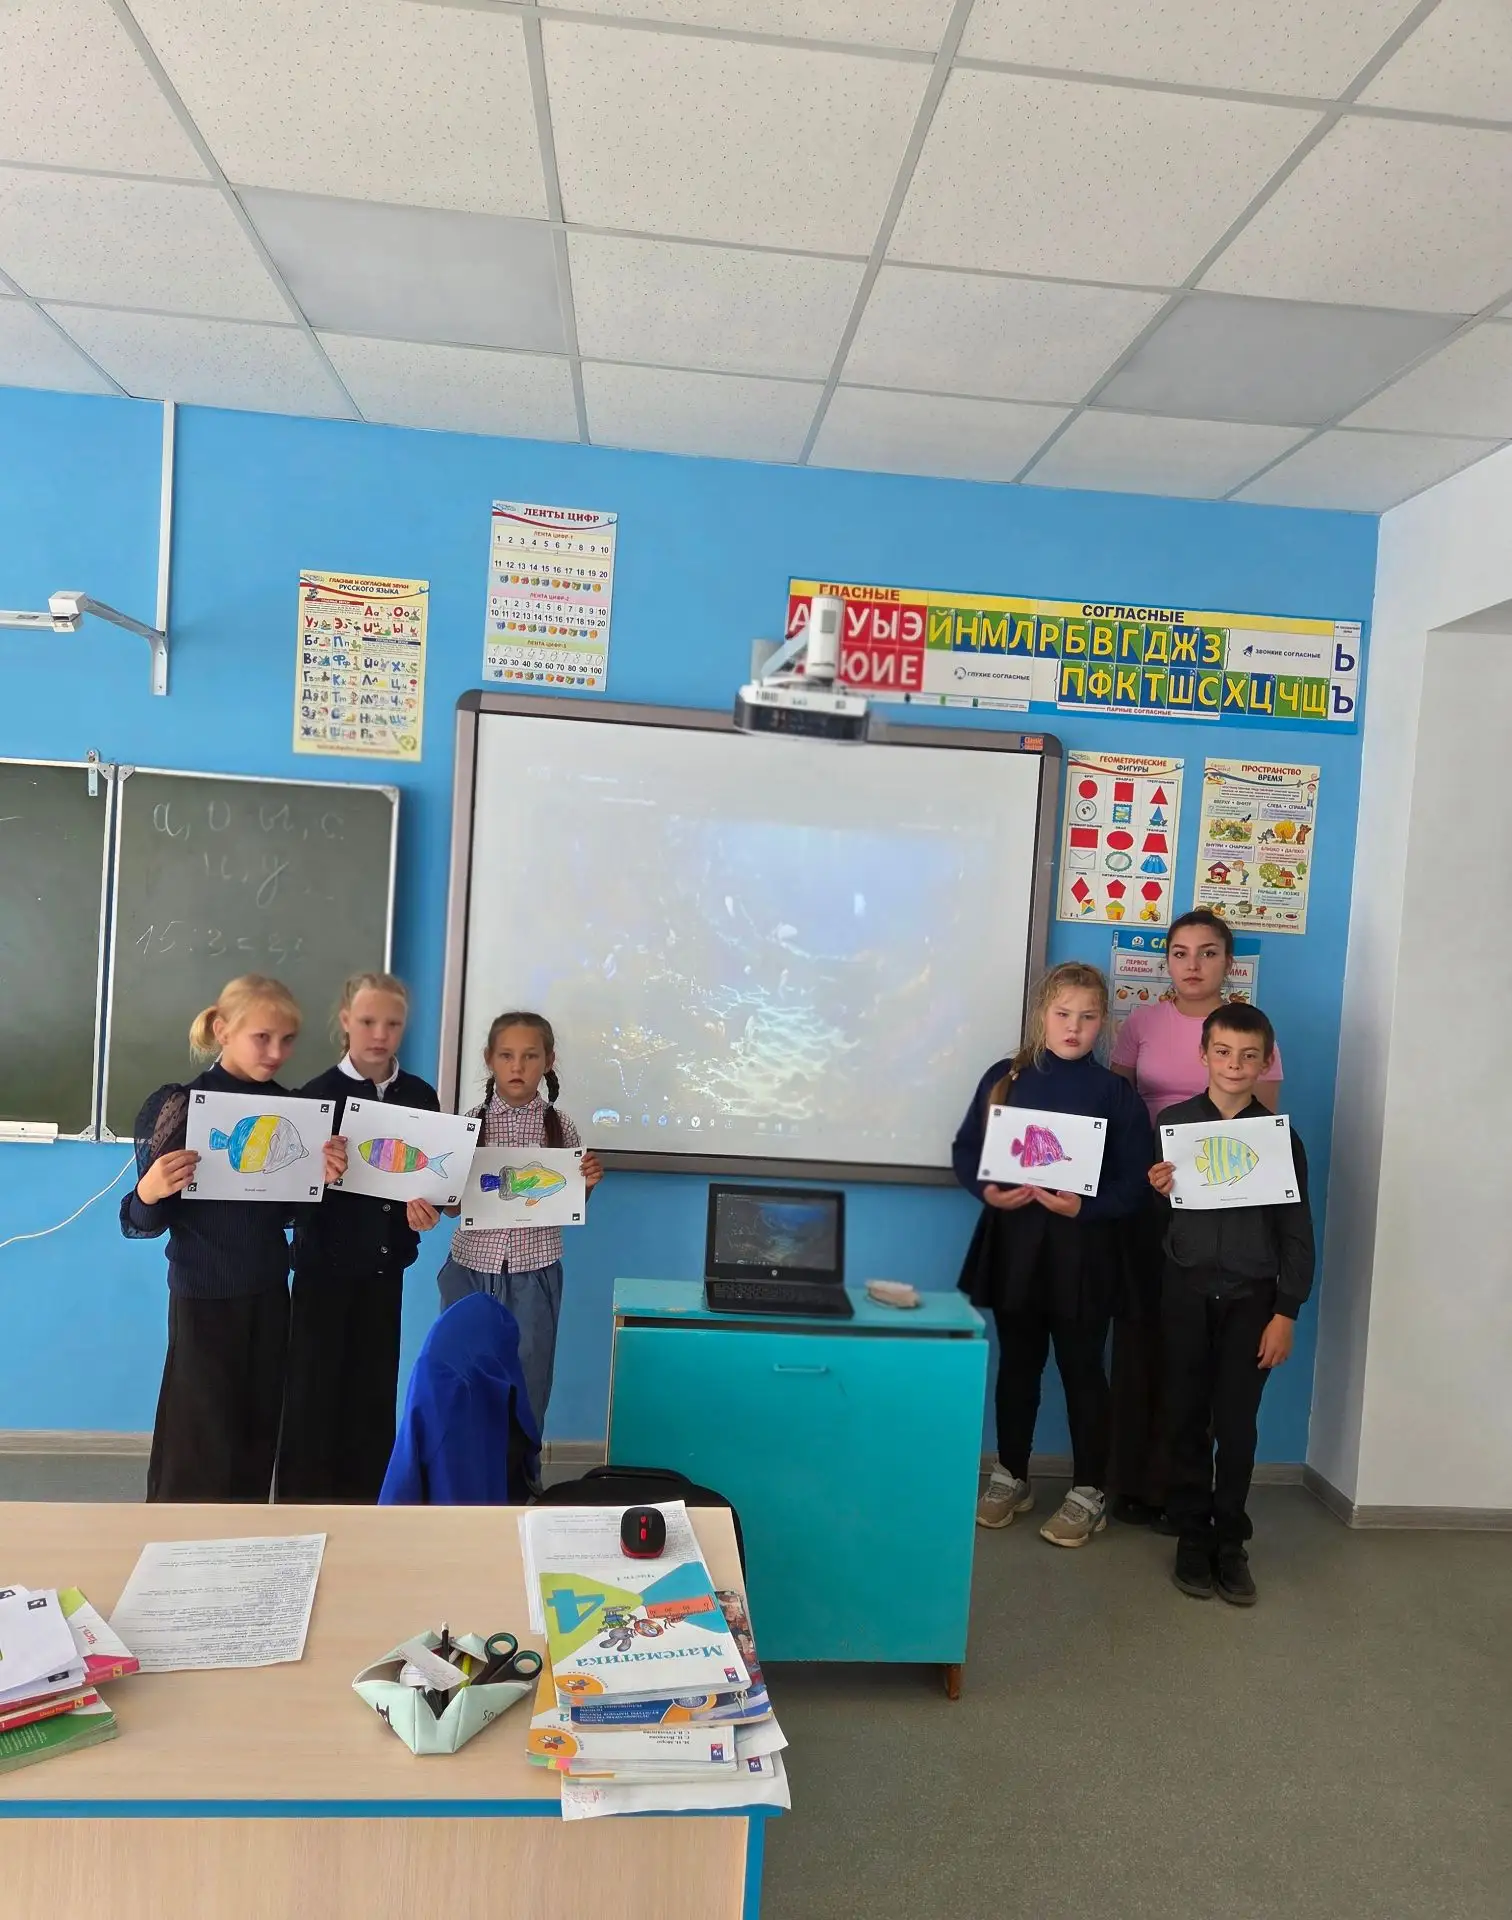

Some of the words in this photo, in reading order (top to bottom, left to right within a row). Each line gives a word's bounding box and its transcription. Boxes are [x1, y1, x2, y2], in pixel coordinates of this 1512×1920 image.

[524, 507, 564, 520] ЛЕНТЫ
[568, 513, 600, 523] ЦИФР
[534, 530, 552, 538] ЛЕНТА
[601, 546, 609, 554] 10
[506, 561, 515, 569] 12
[518, 562, 526, 570] 13
[553, 566, 562, 574] 16
[599, 570, 608, 578] 20
[329, 577, 354, 585] ГЛАСНЫЕ
[360, 580, 391, 588] СОГЛАСНЫЕ
[339, 584, 374, 593] РУССКОГО
[376, 586, 399, 595] ЯЗЫКА
[819, 584, 900, 601] ГЛАСНЫЕ
[530, 592, 548, 600] ЛЕНТА
[1082, 604, 1185, 623] СОГЛАСНЫЕ
[1255, 648, 1282, 657] ЗВОНКИЕ
[1283, 650, 1321, 659] СОГЛАСНЫЕ
[1335, 643, 1355, 672] Ь
[522, 660, 531, 668] 40
[590, 667, 602, 675] 100
[967, 671, 991, 680] ГЛУХИЕ
[992, 672, 1030, 681] СОГЛАСНЫЕ
[1332, 685, 1354, 714] Ъ
[1106, 706, 1132, 714] ПАРНЫЕ
[1133, 708, 1172, 716] СОГЛАСНЫЕ
[1100, 755, 1168, 767] ГЕОМЕТРИЧЕСКИЕ
[1117, 764, 1149, 773] ФИГУРЫ
[1241, 764, 1302, 776] ПРОСТРАНСТВО
[1258, 774, 1284, 783] ВРЕМЯ
[1125, 958, 1149, 967] ПЕРВОЕ
[1119, 966, 1153, 974] СЛАГАЕМОЕ
[546, 1588, 606, 1634] 4
[576, 1644, 725, 1669] Математика
